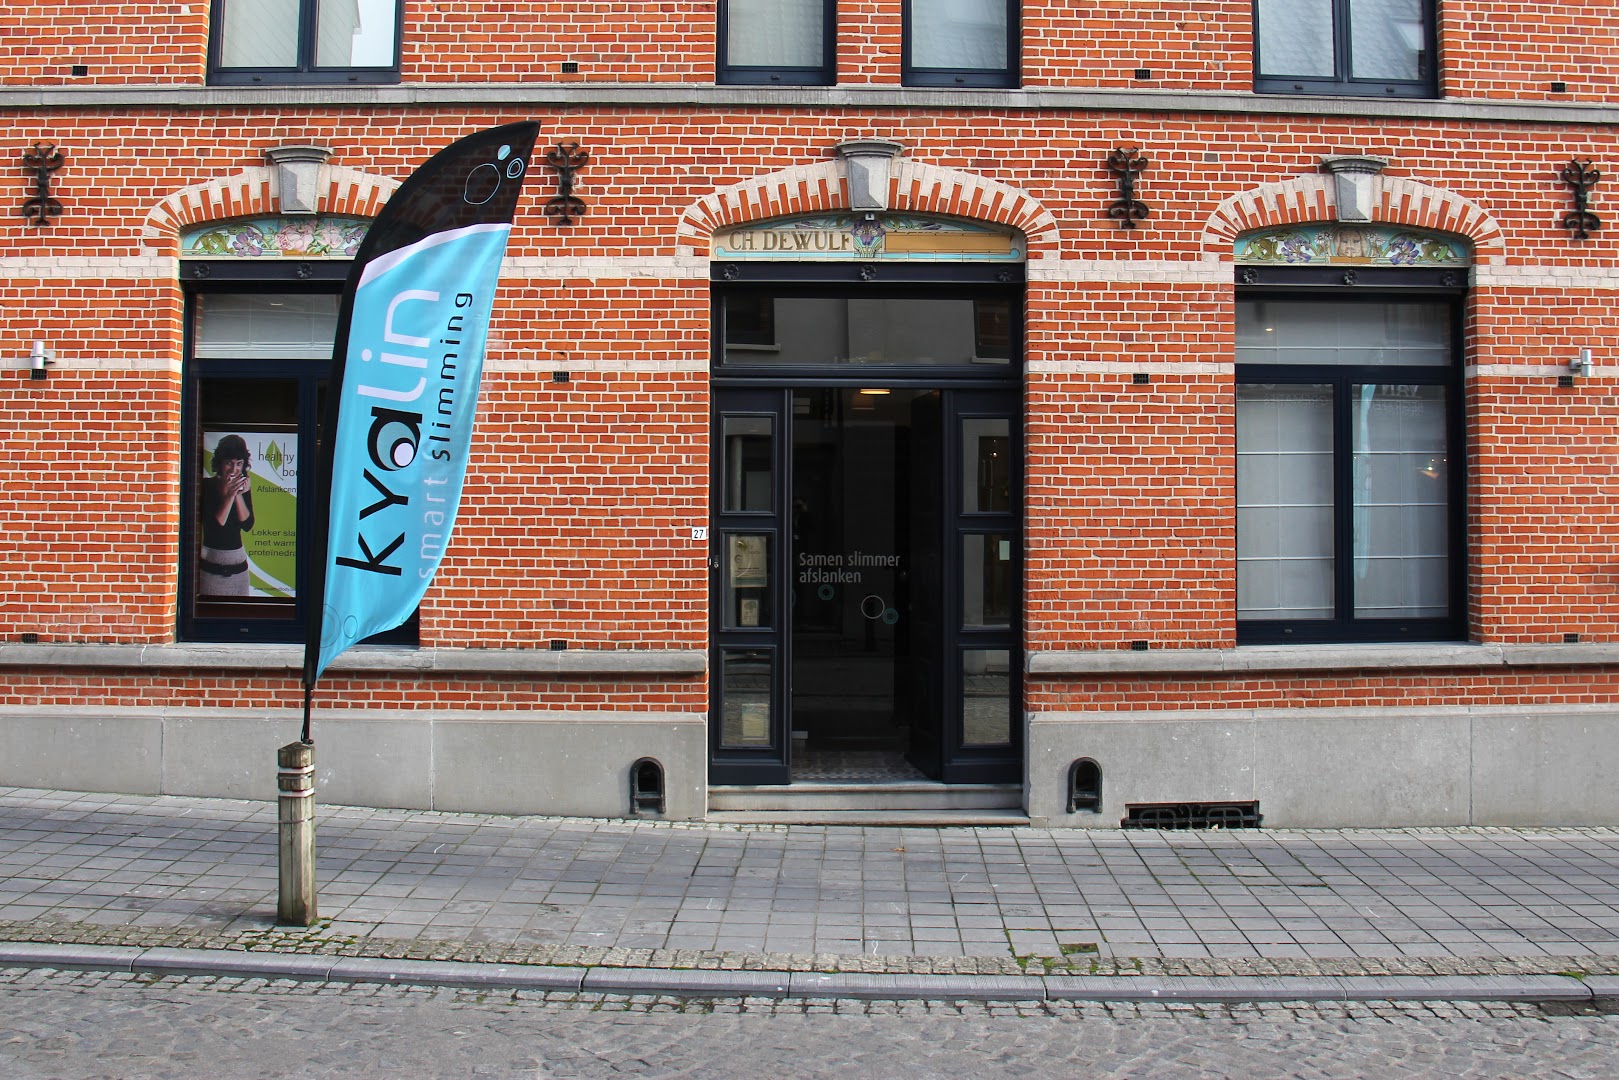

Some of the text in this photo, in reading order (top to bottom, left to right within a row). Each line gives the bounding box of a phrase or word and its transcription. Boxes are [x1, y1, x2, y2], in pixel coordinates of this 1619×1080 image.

[729, 230, 852, 250] CH. DEWULF
[428, 292, 473, 461] slimming
[258, 442, 295, 464] healthy
[418, 476, 448, 579] smart
[693, 529, 704, 539] 27
[799, 551, 900, 567] Samen slimmer
[799, 568, 862, 583] afslanken
